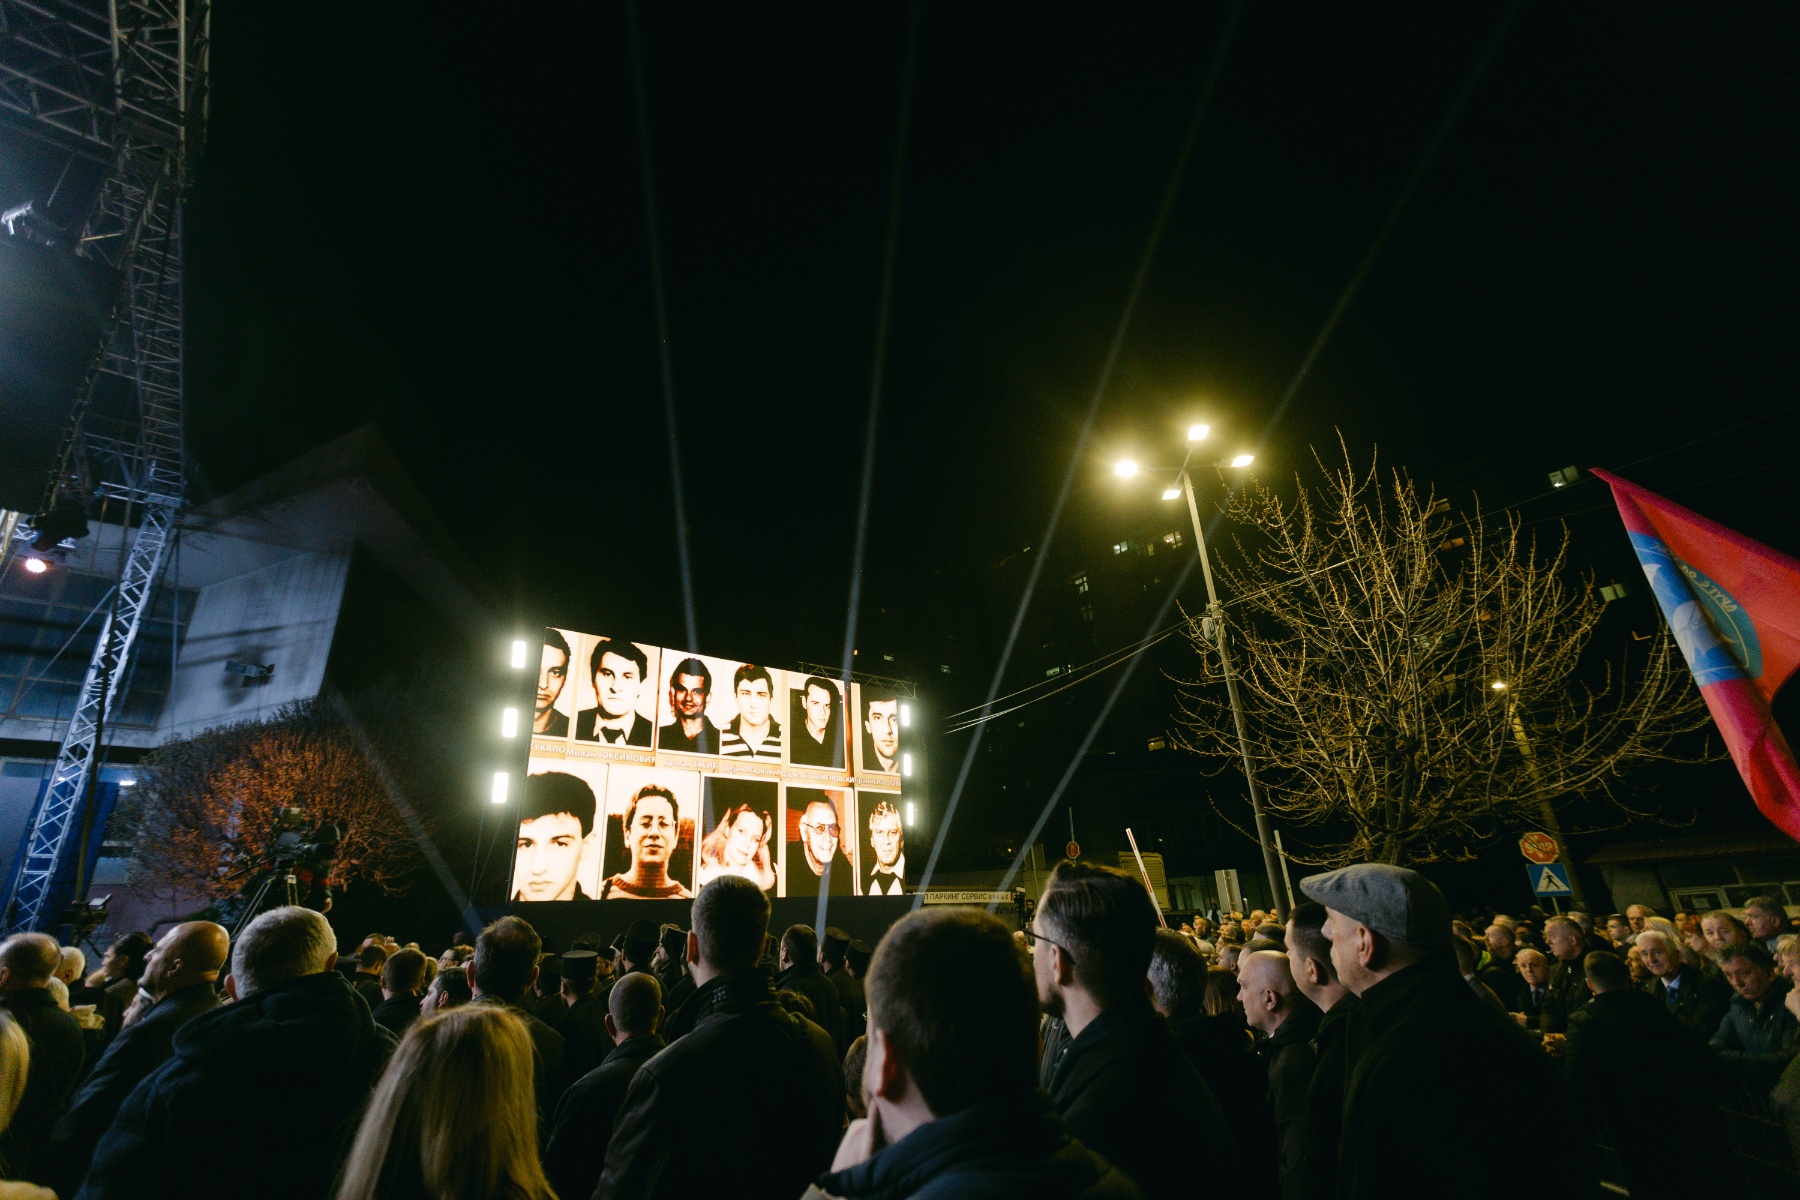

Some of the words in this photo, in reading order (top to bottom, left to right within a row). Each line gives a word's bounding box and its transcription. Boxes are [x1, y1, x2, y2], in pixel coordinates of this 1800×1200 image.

[566, 749, 596, 758] Милан
[664, 758, 692, 767] Драган
[694, 760, 718, 769] ТАСИЋ
[962, 892, 987, 900] СЕРВИС
